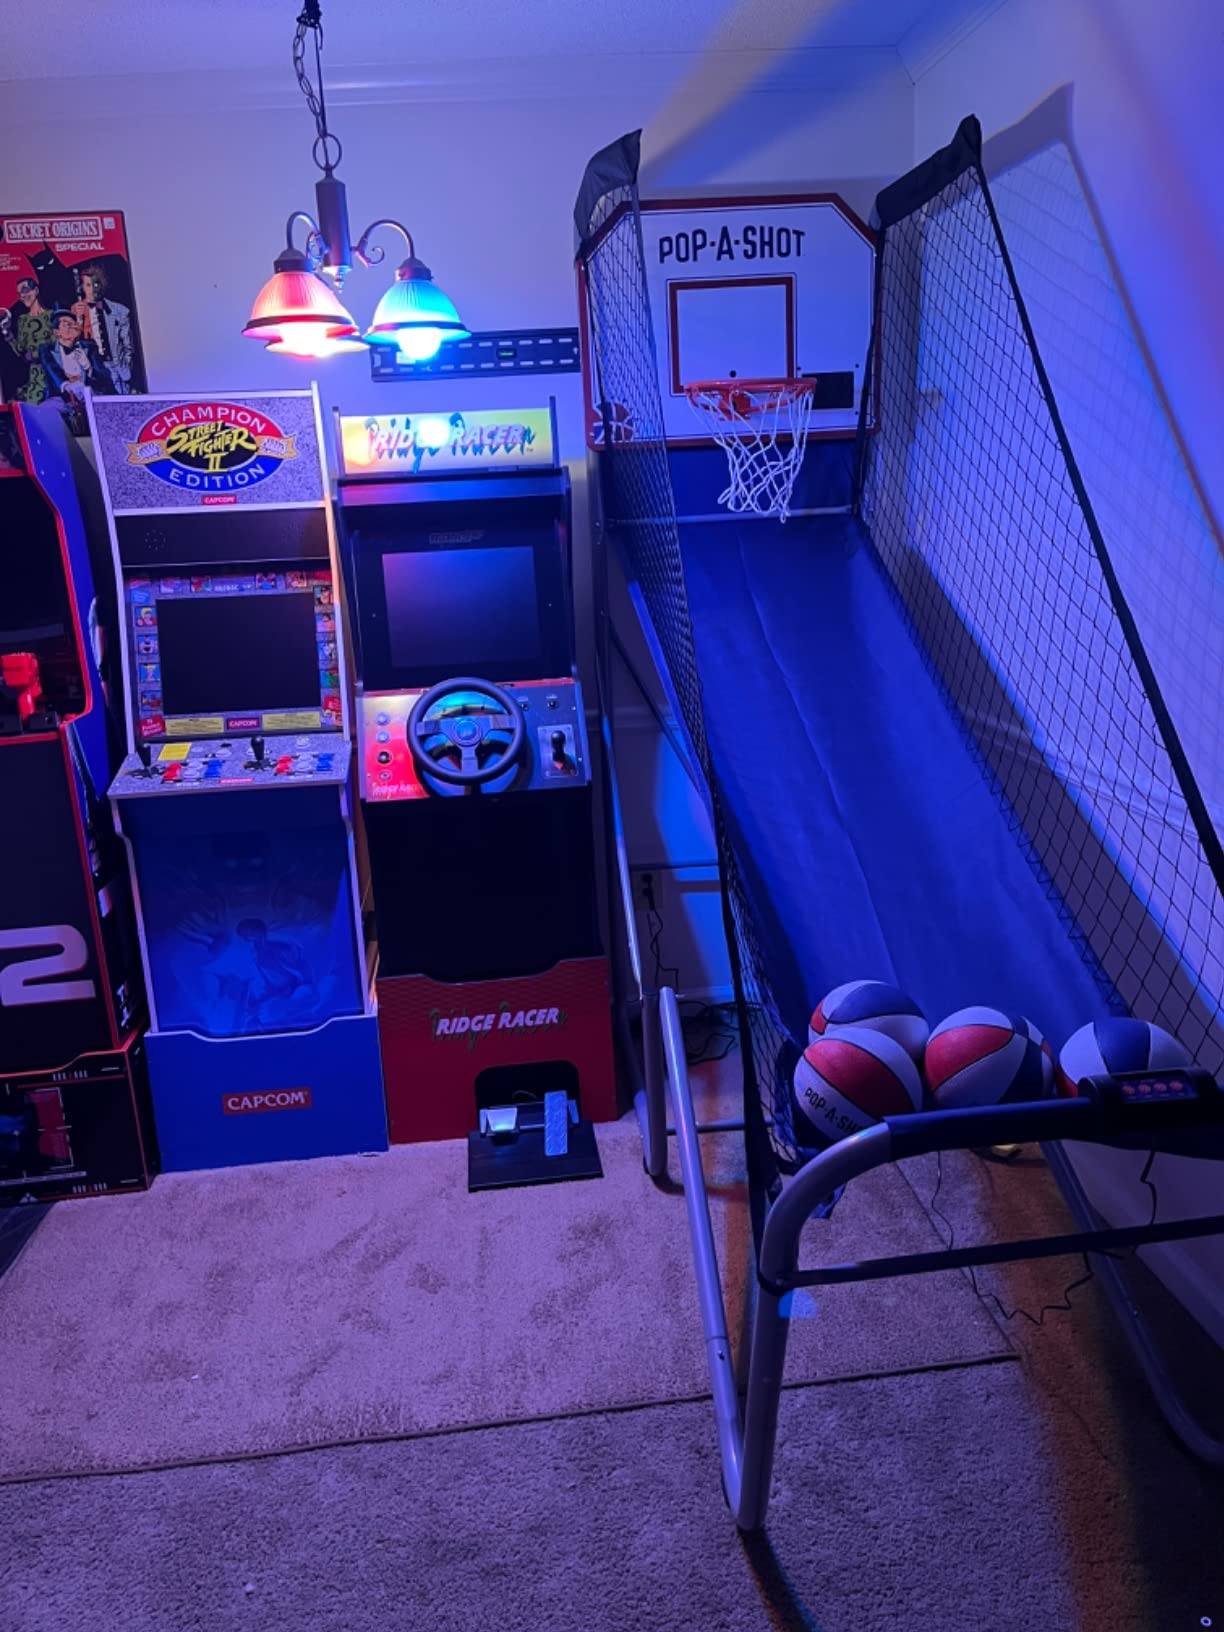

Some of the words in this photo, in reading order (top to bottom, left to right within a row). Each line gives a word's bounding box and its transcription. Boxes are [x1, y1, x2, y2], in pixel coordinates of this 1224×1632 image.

[8, 223, 50, 239] SECRET
[52, 221, 98, 237] ORIGINS
[55, 242, 104, 252] SPECIAL
[151, 406, 266, 437] CHAMPION
[449, 418, 527, 450] RACER
[166, 420, 226, 452] STREET
[184, 427, 257, 458] FIGHTER
[169, 464, 265, 488] EDITION
[203, 453, 230, 473] II
[436, 1013, 496, 1036] RIDGE
[497, 1007, 559, 1029] RACER
[227, 1091, 305, 1110] CAPCOM
